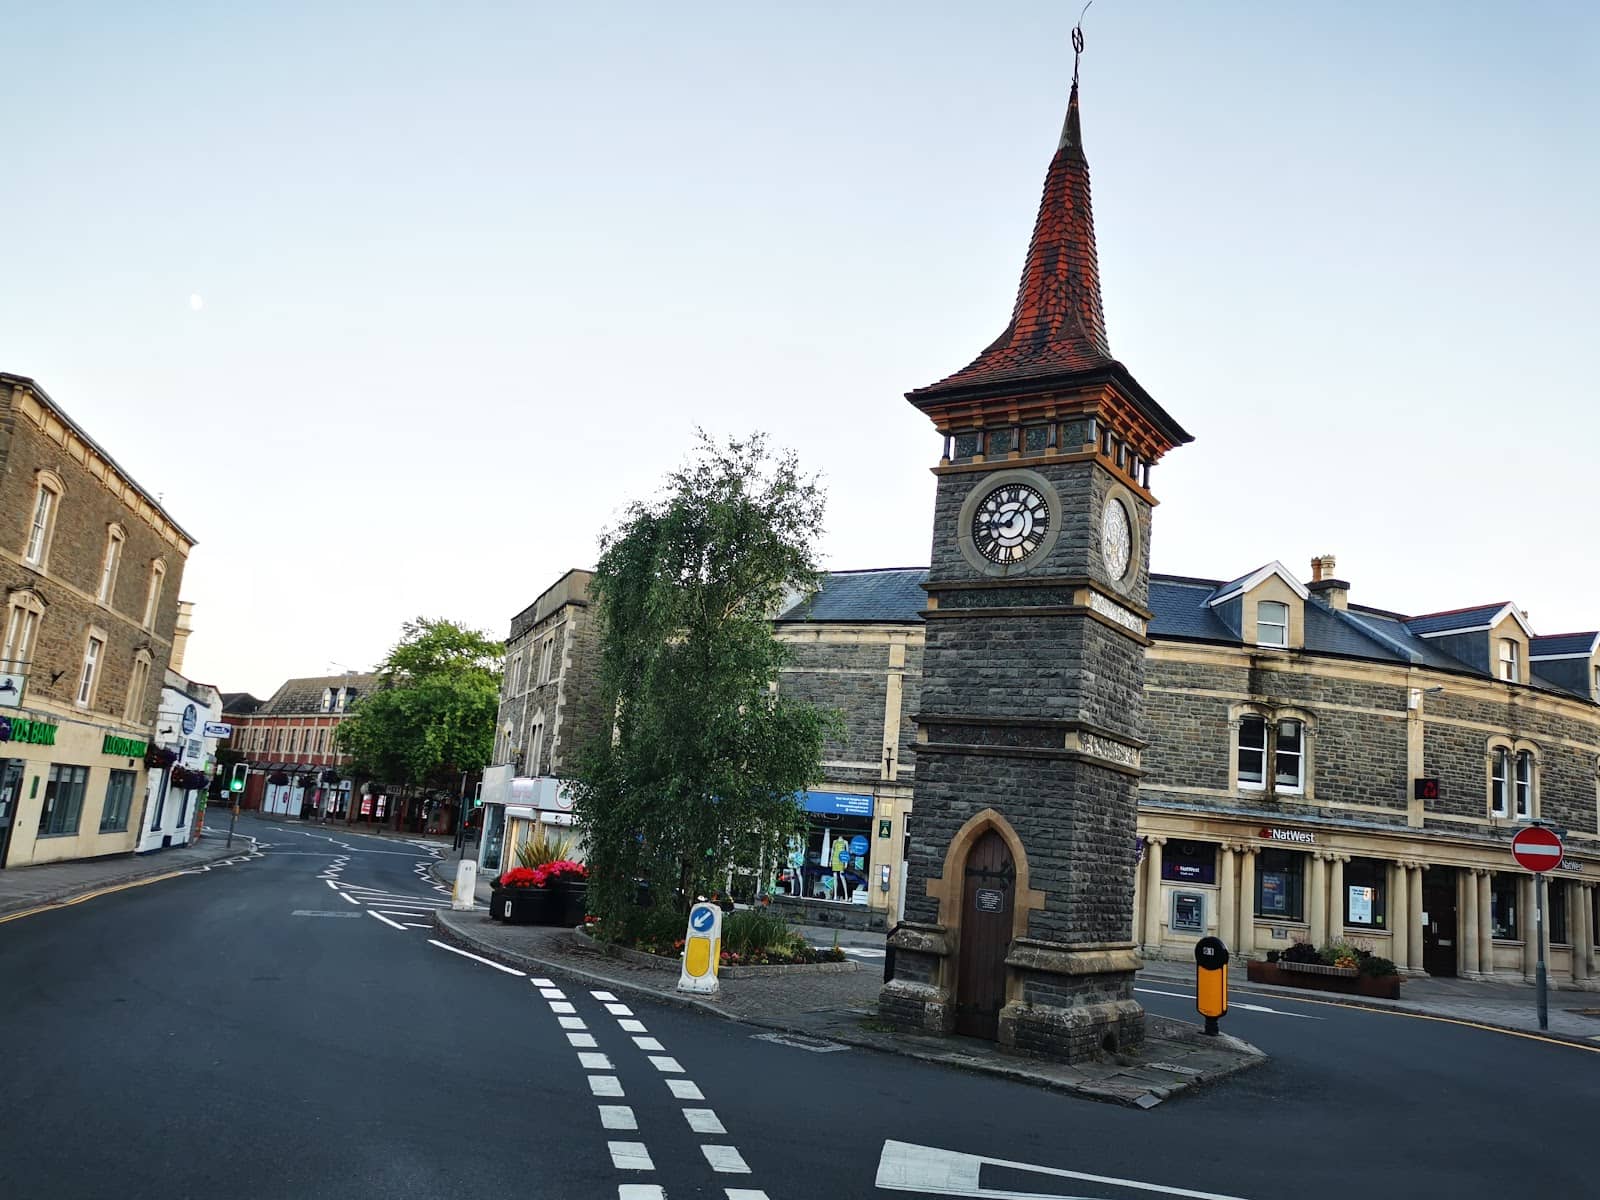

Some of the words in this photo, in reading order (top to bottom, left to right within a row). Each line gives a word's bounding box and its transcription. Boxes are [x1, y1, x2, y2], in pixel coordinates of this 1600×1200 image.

[31, 721, 59, 745] BANK
[102, 735, 130, 757] LLOYDS
[130, 740, 147, 758] BANK
[1272, 829, 1315, 843] NatWest
